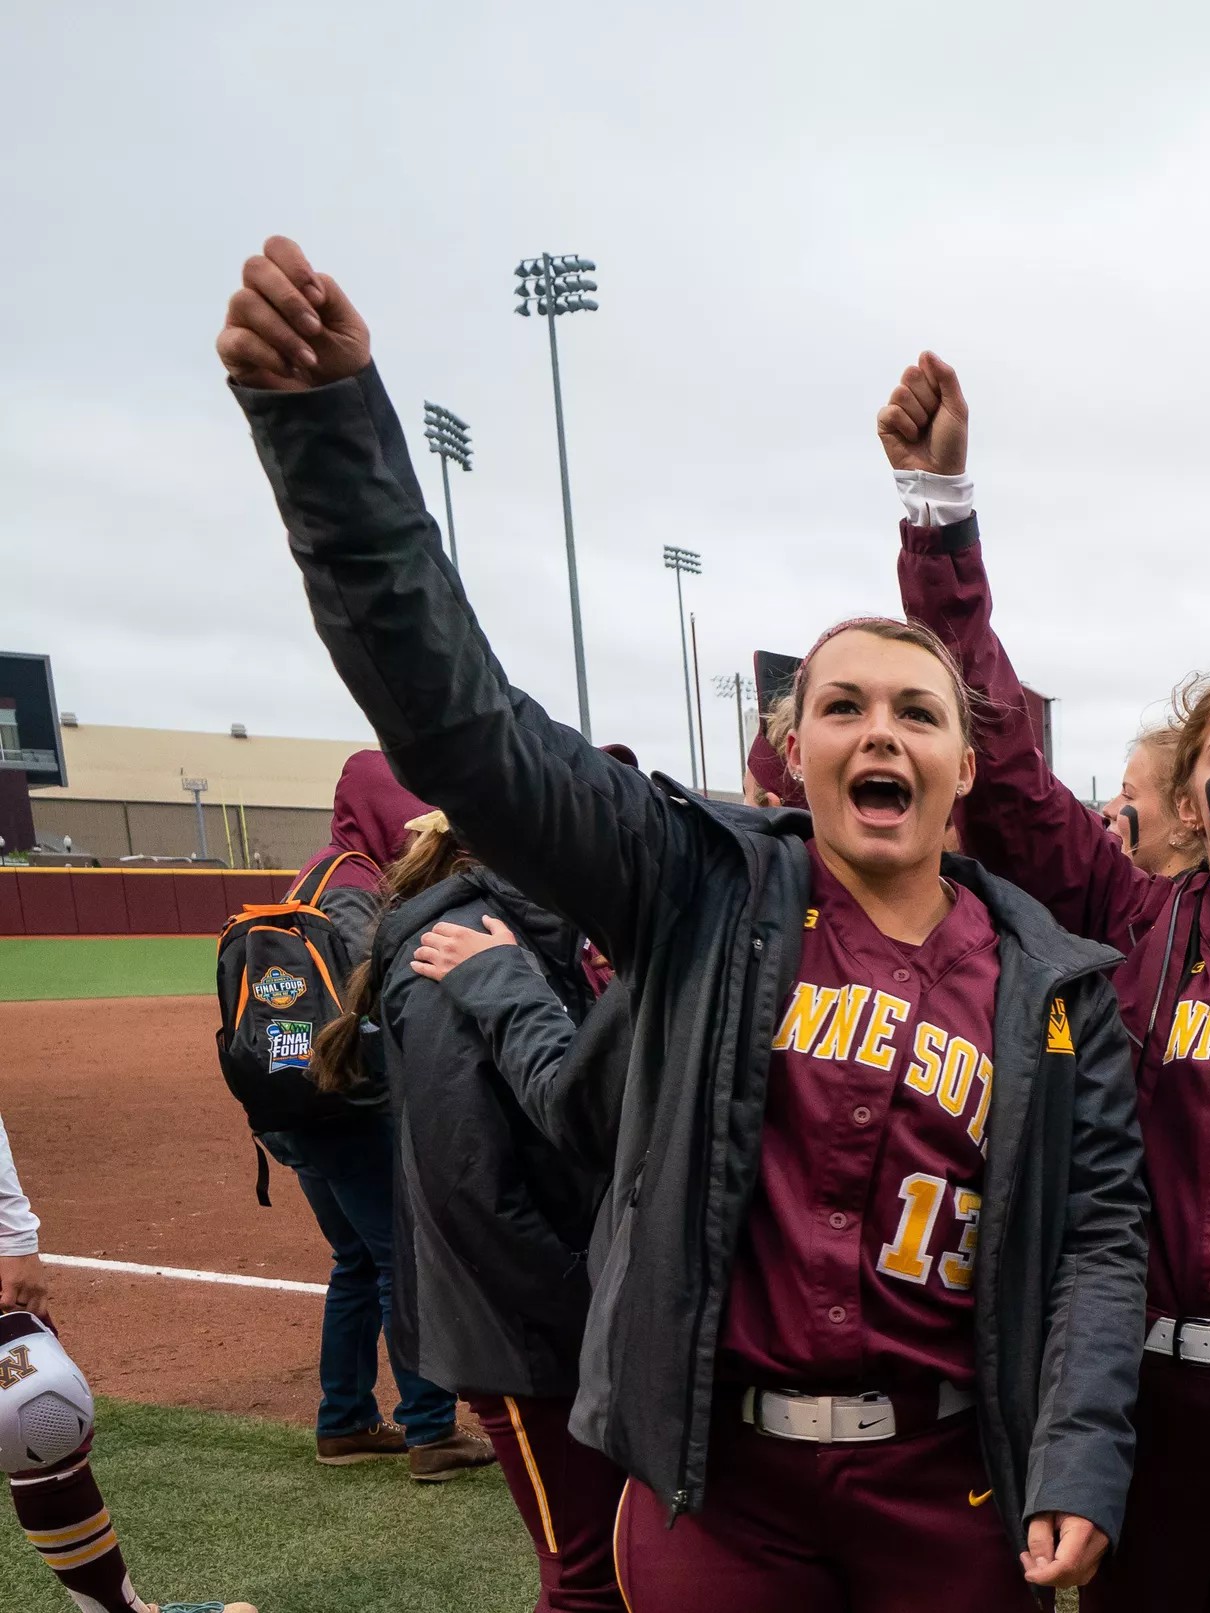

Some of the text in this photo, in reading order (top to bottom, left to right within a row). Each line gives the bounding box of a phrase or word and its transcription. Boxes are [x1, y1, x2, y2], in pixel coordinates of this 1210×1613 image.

[255, 983, 280, 995] FINAL
[280, 980, 304, 992] FOUR
[273, 1032, 309, 1047] FINAL
[272, 1043, 309, 1058] FOUR
[876, 1172, 983, 1291] 13
